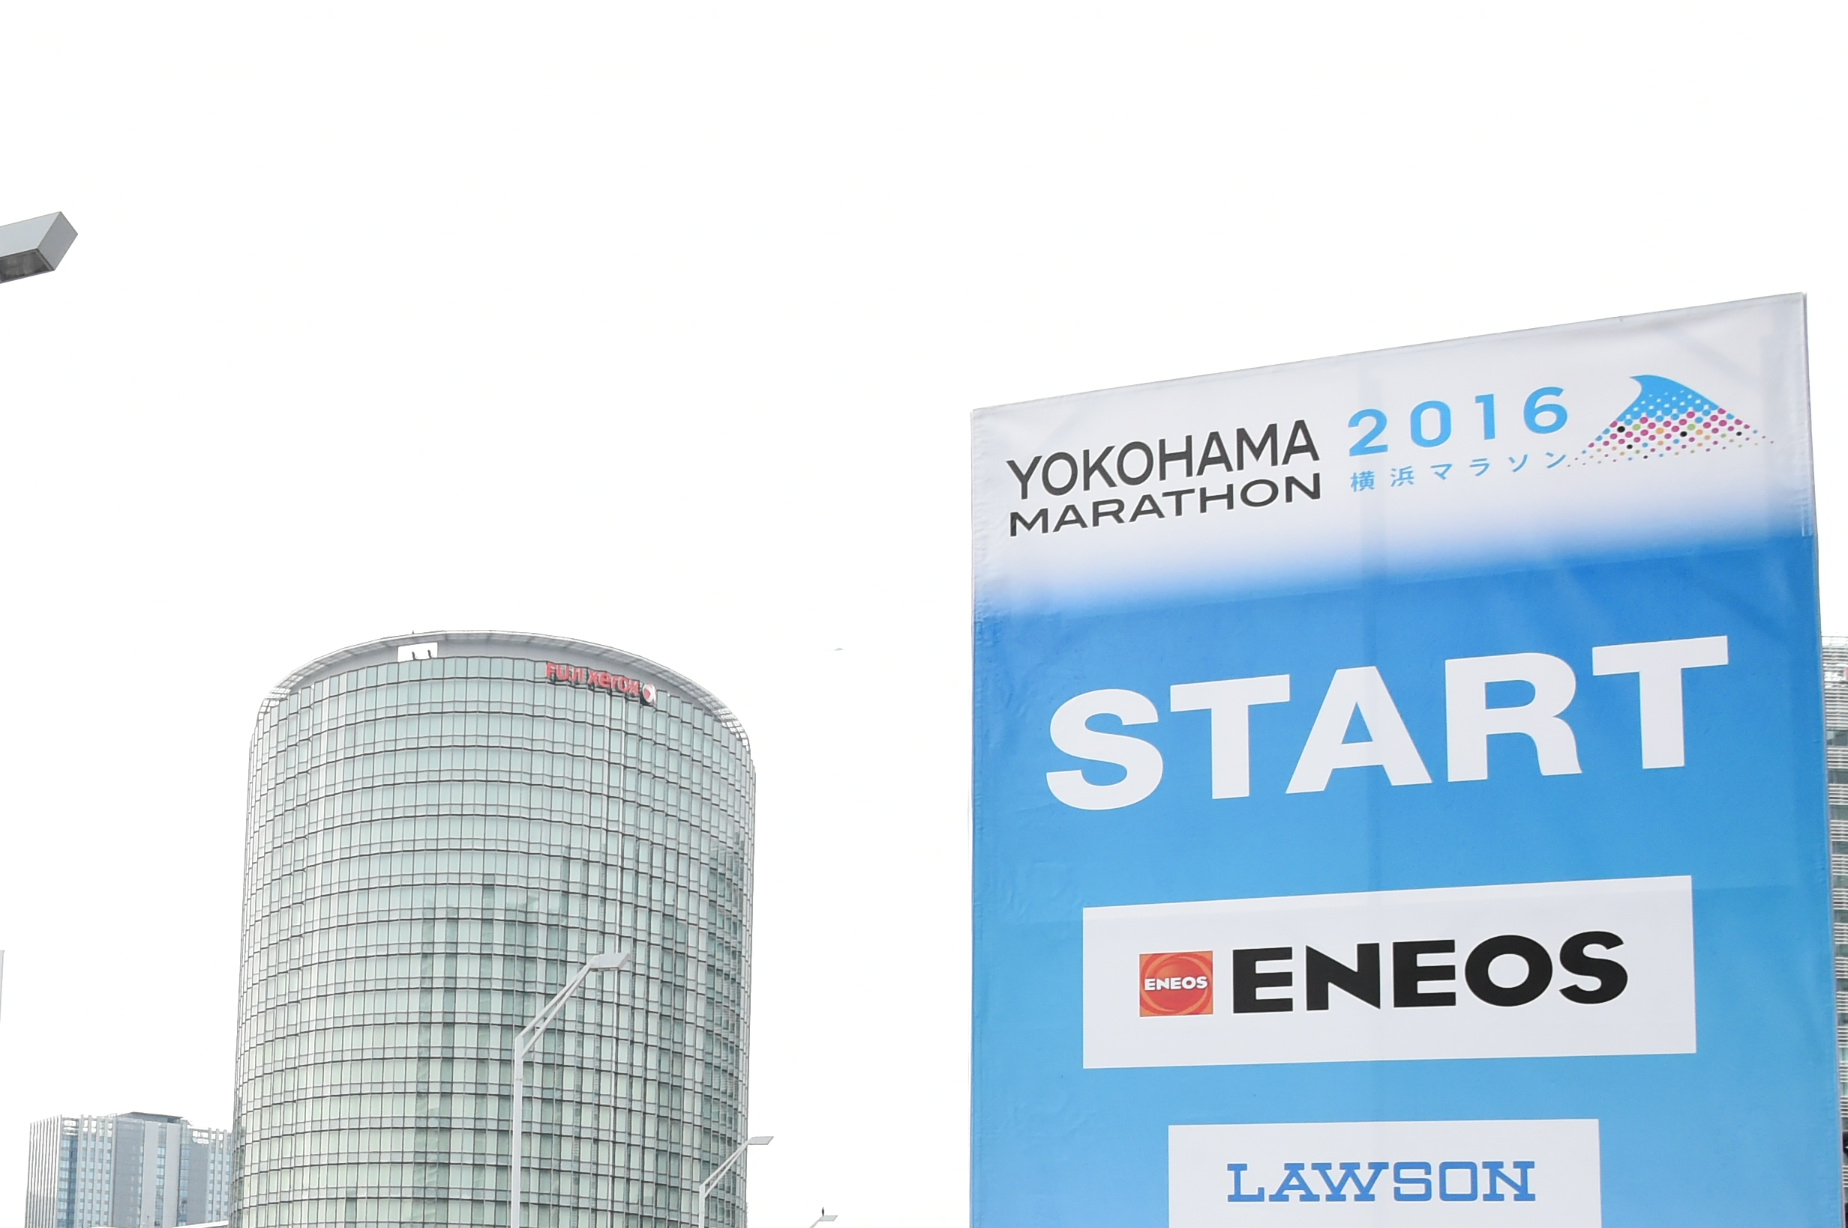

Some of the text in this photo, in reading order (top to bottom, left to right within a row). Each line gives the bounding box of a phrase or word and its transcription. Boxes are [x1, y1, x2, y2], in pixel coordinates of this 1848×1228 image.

[1348, 386, 1569, 456] 2016
[1006, 418, 1320, 502] YOKOHAMA
[1349, 452, 1567, 493] 横浜マラソン
[1008, 472, 1322, 538] MARATHON
[1045, 635, 1730, 812] START
[1144, 975, 1209, 993] ENEOS
[1232, 930, 1629, 1014] ENEOS
[1226, 1160, 1536, 1202] LAWSON
